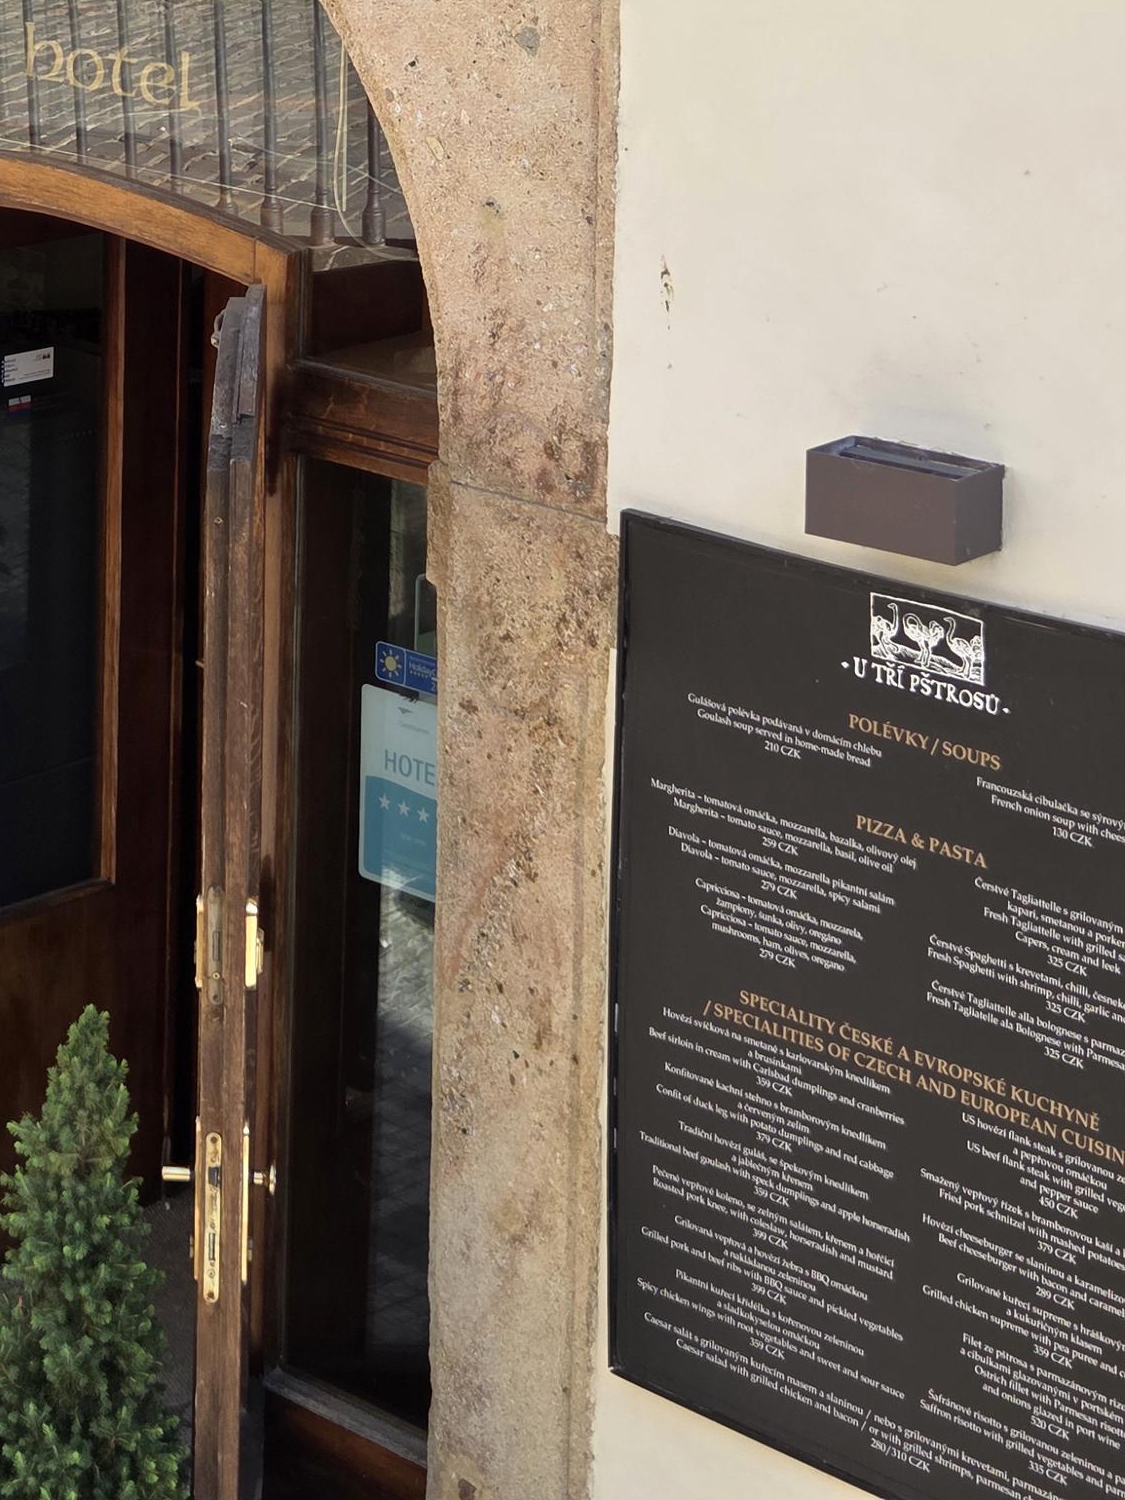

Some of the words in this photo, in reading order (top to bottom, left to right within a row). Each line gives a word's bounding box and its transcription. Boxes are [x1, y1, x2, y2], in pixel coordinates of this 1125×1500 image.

[852, 655, 869, 679] U
[870, 661, 905, 690] TŘÍ
[909, 671, 998, 716] PŠTROSŮ
[697, 708, 732, 727] Goulash
[732, 720, 754, 735] soup
[754, 727, 783, 742] served
[784, 733, 794, 745] in
[794, 735, 845, 760] home-made
[846, 751, 871, 768] bread
[764, 739, 780, 753] 210
[780, 745, 802, 760] CZK
[804, 728, 811, 737] v
[852, 741, 882, 758] chlebu
[848, 713, 929, 750] POLÉVKY
[930, 737, 940, 756] /
[942, 740, 1001, 771] SOUPS
[991, 793, 1023, 813] French
[1023, 806, 1051, 821] onion
[1052, 814, 1076, 831] soup
[1077, 822, 1099, 836] with
[1079, 809, 1091, 820] se
[673, 796, 719, 819] Margherita
[727, 814, 757, 830] tomato
[858, 854, 881, 869] olive
[880, 862, 893, 874] oil
[761, 836, 778, 849] 259
[777, 841, 799, 856] CZK
[856, 814, 907, 845] PIZZA
[910, 832, 925, 850] &
[929, 836, 988, 869] PASTA
[1052, 826, 1069, 840] 130
[1069, 831, 1093, 848] CZK
[1046, 954, 1064, 969] 325
[1064, 960, 1088, 977] CZK
[1051, 945, 1080, 961] cream
[1081, 954, 1100, 968] and
[1101, 958, 1121, 975] leek
[648, 1026, 667, 1041] Beef
[667, 1034, 695, 1050] sirloin
[695, 1042, 704, 1054] in
[704, 1048, 731, 1063] cream
[732, 1056, 752, 1070] with
[752, 1062, 790, 1084] Carlsbad
[791, 1076, 838, 1102] dumplings
[838, 1095, 856, 1108] and
[856, 1101, 905, 1125] cranberries
[702, 999, 712, 1016] /
[713, 1002, 824, 1053] SPECIALITIES
[827, 1042, 851, 1062] OF
[853, 1051, 912, 1085] CZECH
[915, 1074, 956, 1099] AND
[960, 1089, 1057, 1139] EUROPEAN
[739, 989, 836, 1035] SPECIALITY
[839, 1021, 893, 1056] ČESKÉ
[897, 1045, 910, 1062] A
[914, 1049, 1007, 1097] EVROPSKÉ
[1010, 1084, 1100, 1132] KUCHYNĚ
[755, 1075, 771, 1088] 359
[771, 1081, 793, 1097] CZK
[655, 1083, 682, 1101] Confit
[682, 1094, 692, 1104] of
[692, 1096, 714, 1112] duck
[715, 1103, 729, 1120] leg
[729, 1110, 749, 1124] with
[750, 1118, 777, 1135] potato
[777, 1127, 824, 1154] dumplings
[824, 1146, 842, 1159] and
[843, 1153, 858, 1165] red
[858, 1159, 895, 1180] cabbage
[755, 1130, 771, 1144] 379
[771, 1137, 792, 1153] CZK
[966, 1139, 981, 1154] US
[981, 1145, 1001, 1162] beef
[1002, 1154, 1026, 1172] flank
[1026, 1166, 1051, 1182] steak
[1052, 1175, 1073, 1191] with
[1074, 1185, 1105, 1203] grilled
[1019, 1176, 1038, 1190] and
[1039, 1184, 1072, 1203] pepper
[1072, 1197, 1099, 1214] sauce
[1038, 1195, 1055, 1210] 450
[1055, 1202, 1079, 1220] CZK
[939, 1187, 962, 1206] Fried
[963, 1199, 985, 1215] pork
[986, 1209, 1026, 1231] schnitzel
[1027, 1225, 1049, 1241] with
[1050, 1234, 1086, 1256] mashed
[1037, 1240, 1054, 1255] 379
[1054, 1247, 1077, 1265] CZK
[982, 1383, 1000, 1397] and
[1000, 1391, 1032, 1411] onions
[1032, 1405, 1063, 1425] glazed
[1064, 1417, 1075, 1430] in
[1075, 1424, 1096, 1440] port
[1097, 1433, 1121, 1450] wine
[1030, 1414, 1047, 1430] 520
[1047, 1423, 1070, 1441] CZK
[908, 1455, 931, 1474] CZK
